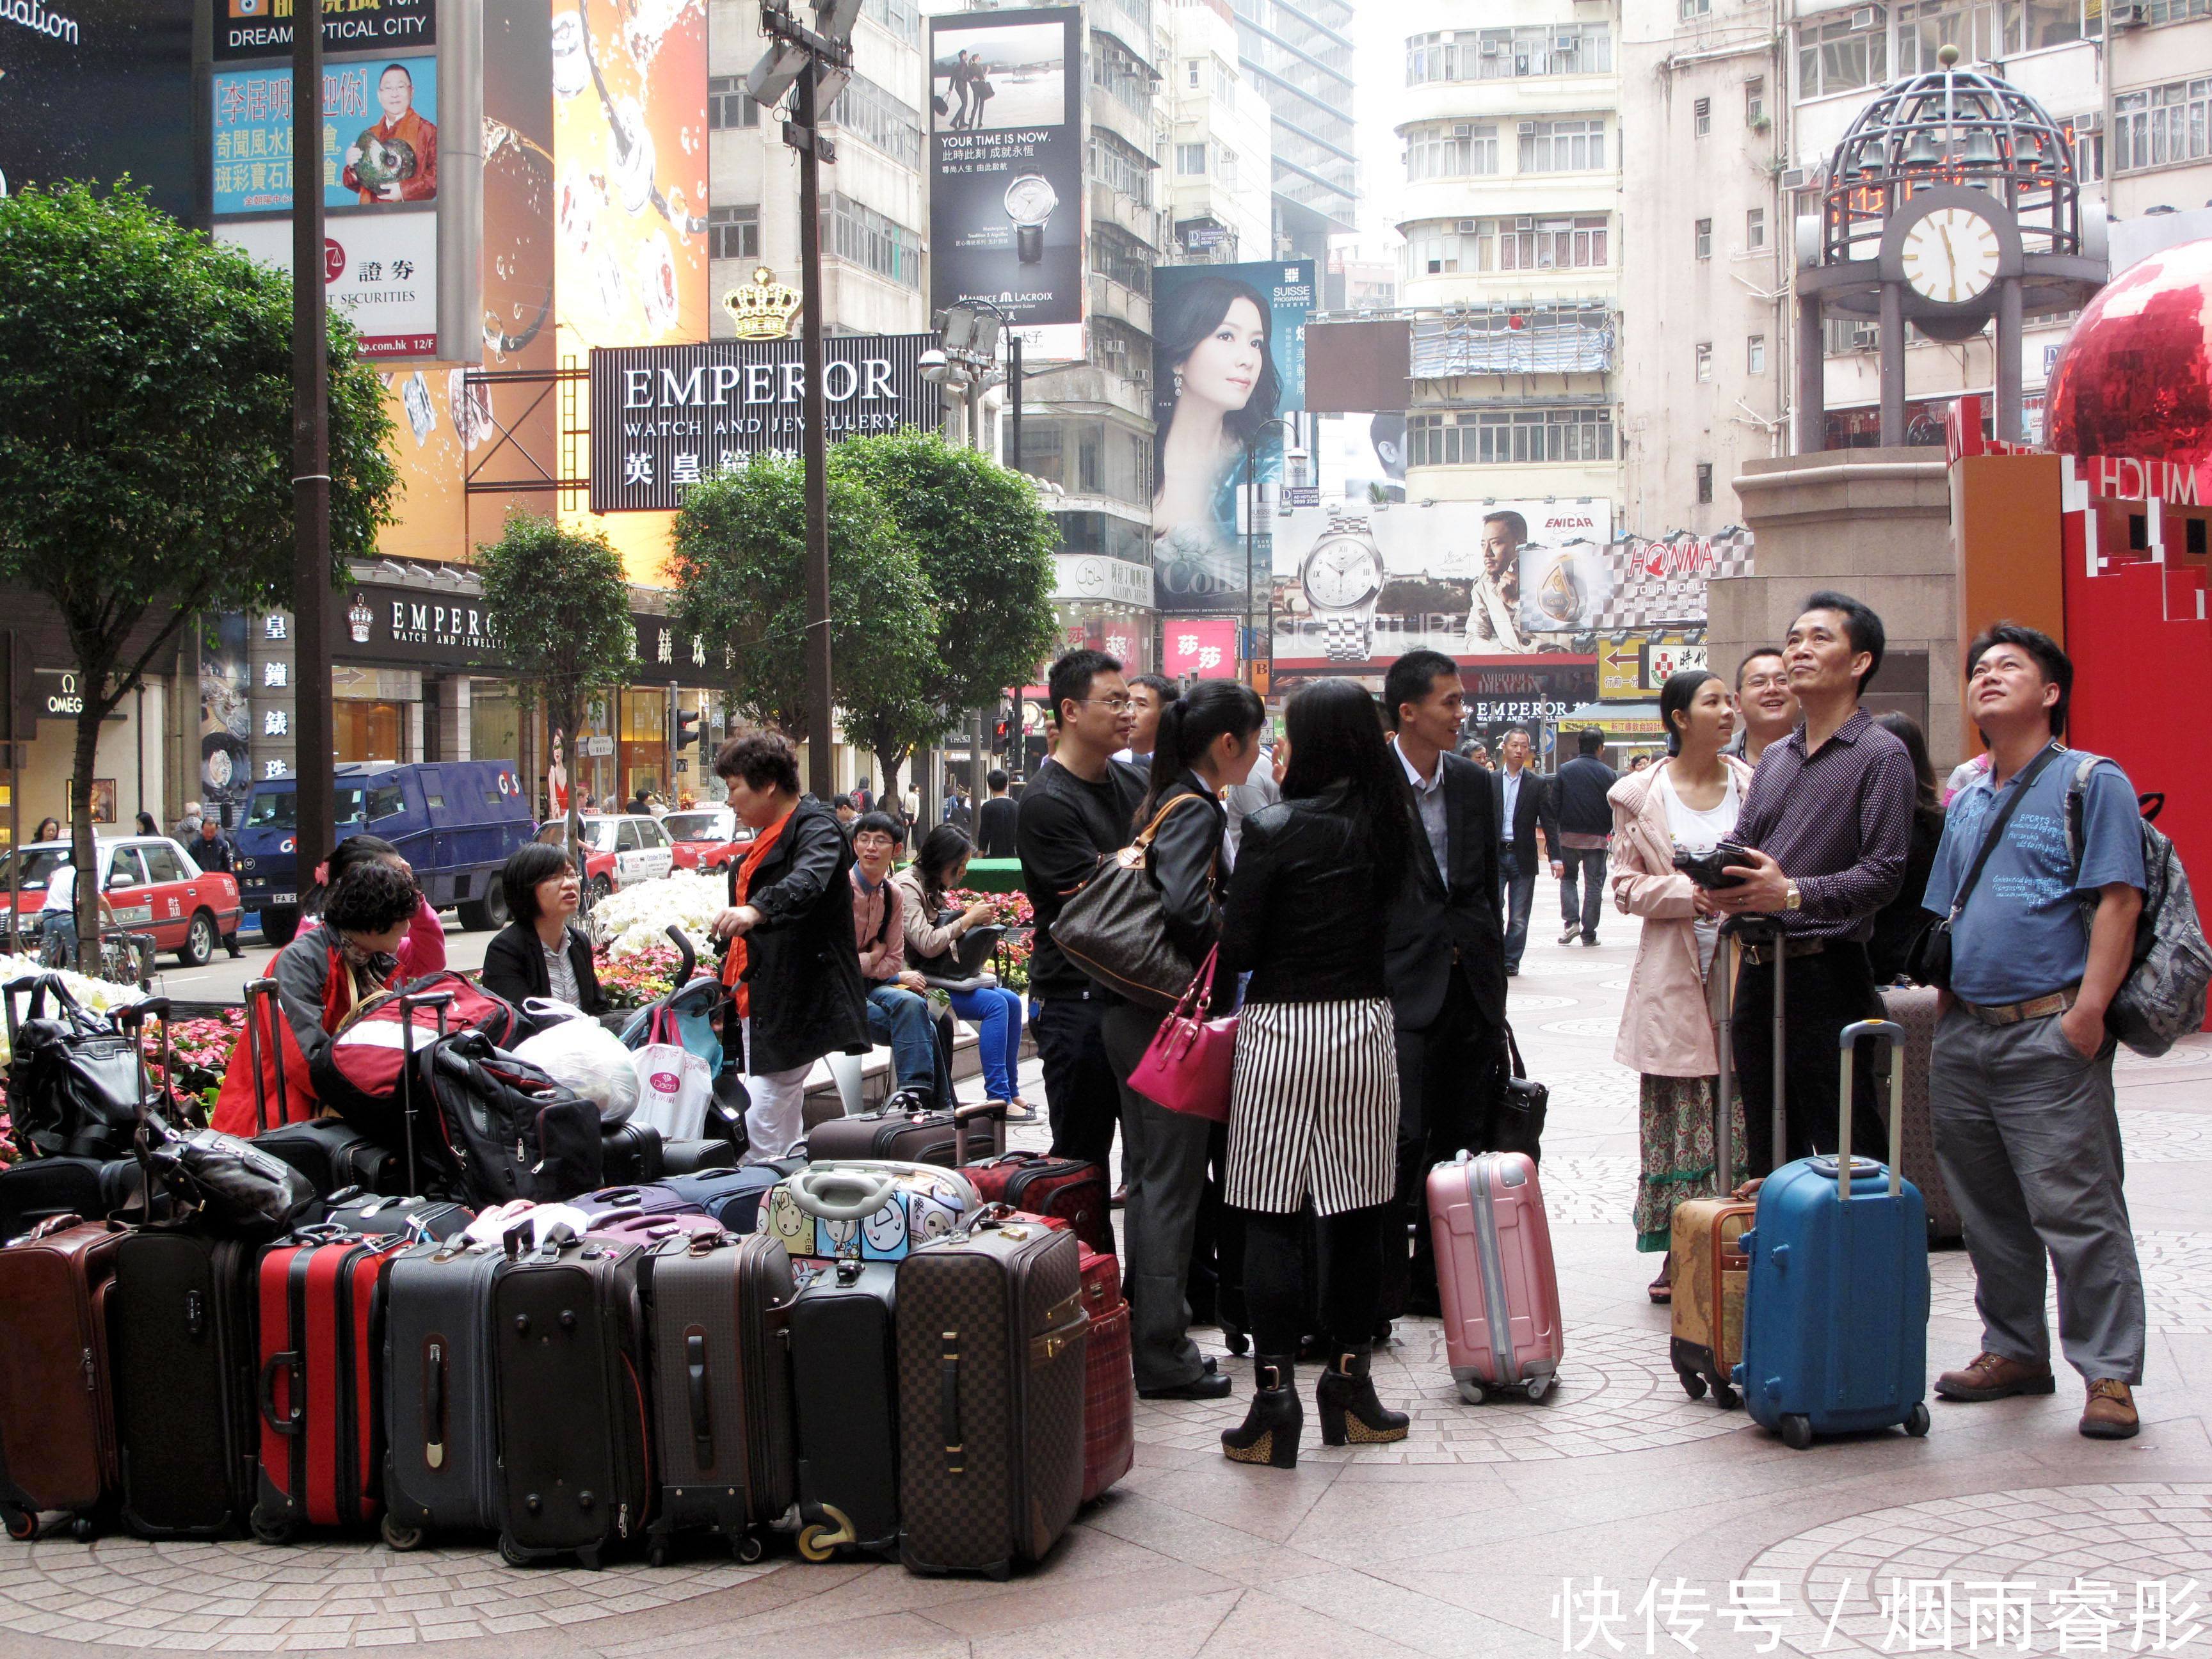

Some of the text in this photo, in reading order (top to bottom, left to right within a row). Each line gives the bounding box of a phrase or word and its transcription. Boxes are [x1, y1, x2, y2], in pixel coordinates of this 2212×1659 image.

[384, 16, 427, 35] CITY
[942, 131, 1052, 148] YOUR TIME IS NOW.
[942, 148, 986, 162] 此時此刻
[341, 291, 415, 305] SECURITIES
[1014, 292, 1053, 302] LACROIX
[1273, 285, 1310, 297] SUISSE
[413, 339, 434, 350] 12/F
[623, 358, 899, 408] EMPEROR
[624, 421, 703, 438] WATCH
[714, 417, 762, 435] AND
[1545, 517, 1594, 529] ENICAR
[1628, 540, 1717, 578] HONMA
[1134, 588, 1148, 603] MESS
[1633, 584, 1664, 596] TOUR
[393, 630, 427, 643] WATCH
[437, 635, 456, 645] AND
[48, 696, 83, 713] OMEG
[1477, 701, 1568, 716] EMPEROR
[225, 887, 236, 896] TAXI
[169, 906, 180, 917] TAXI
